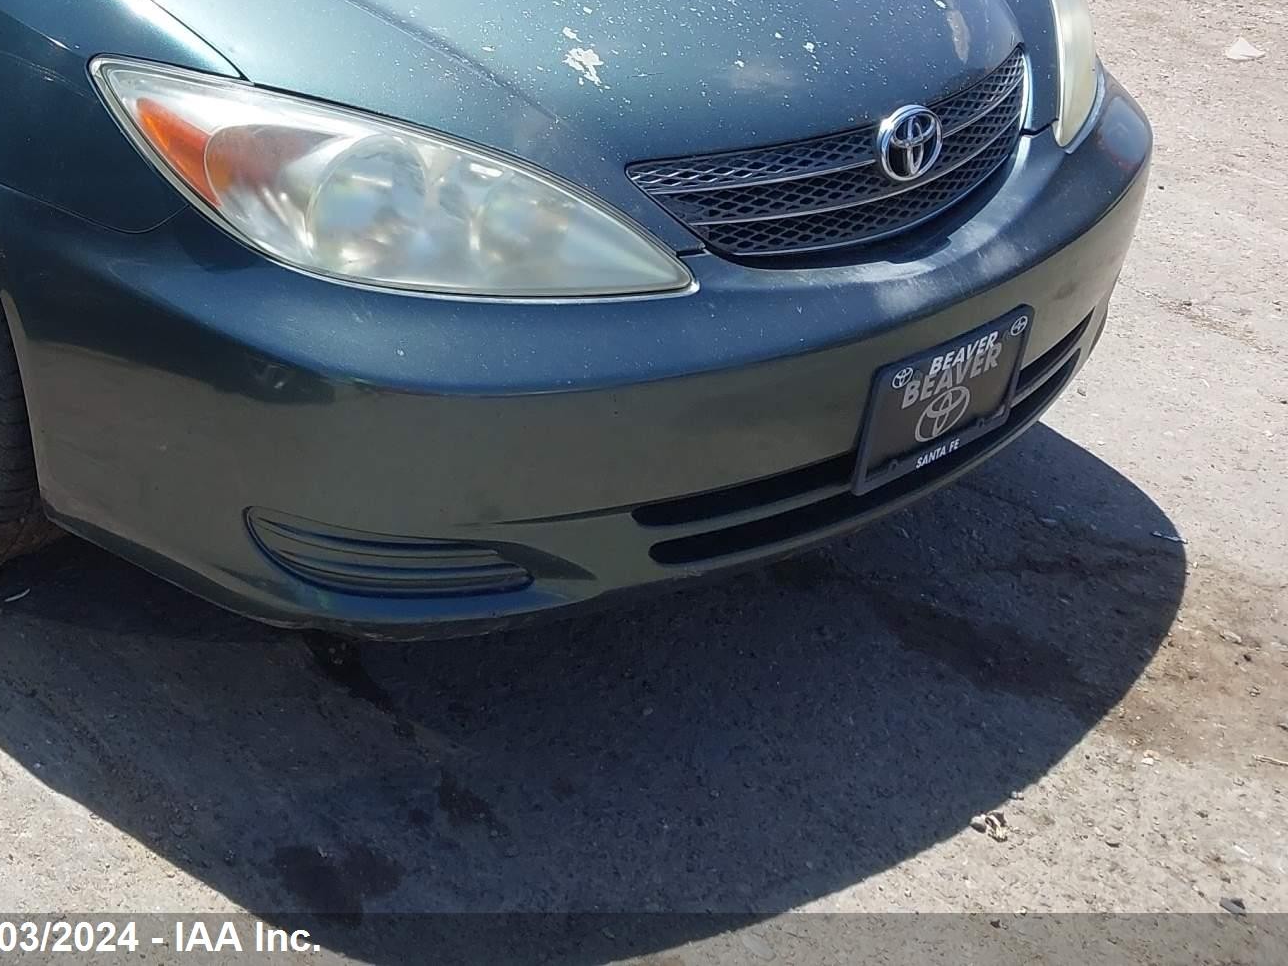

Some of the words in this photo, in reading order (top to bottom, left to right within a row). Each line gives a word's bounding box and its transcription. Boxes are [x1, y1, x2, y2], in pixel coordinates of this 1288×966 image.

[901, 341, 1003, 409] BEAVER
[929, 330, 999, 376] BEAVER
[915, 444, 947, 469] SANTA
[949, 438, 961, 454] FE
